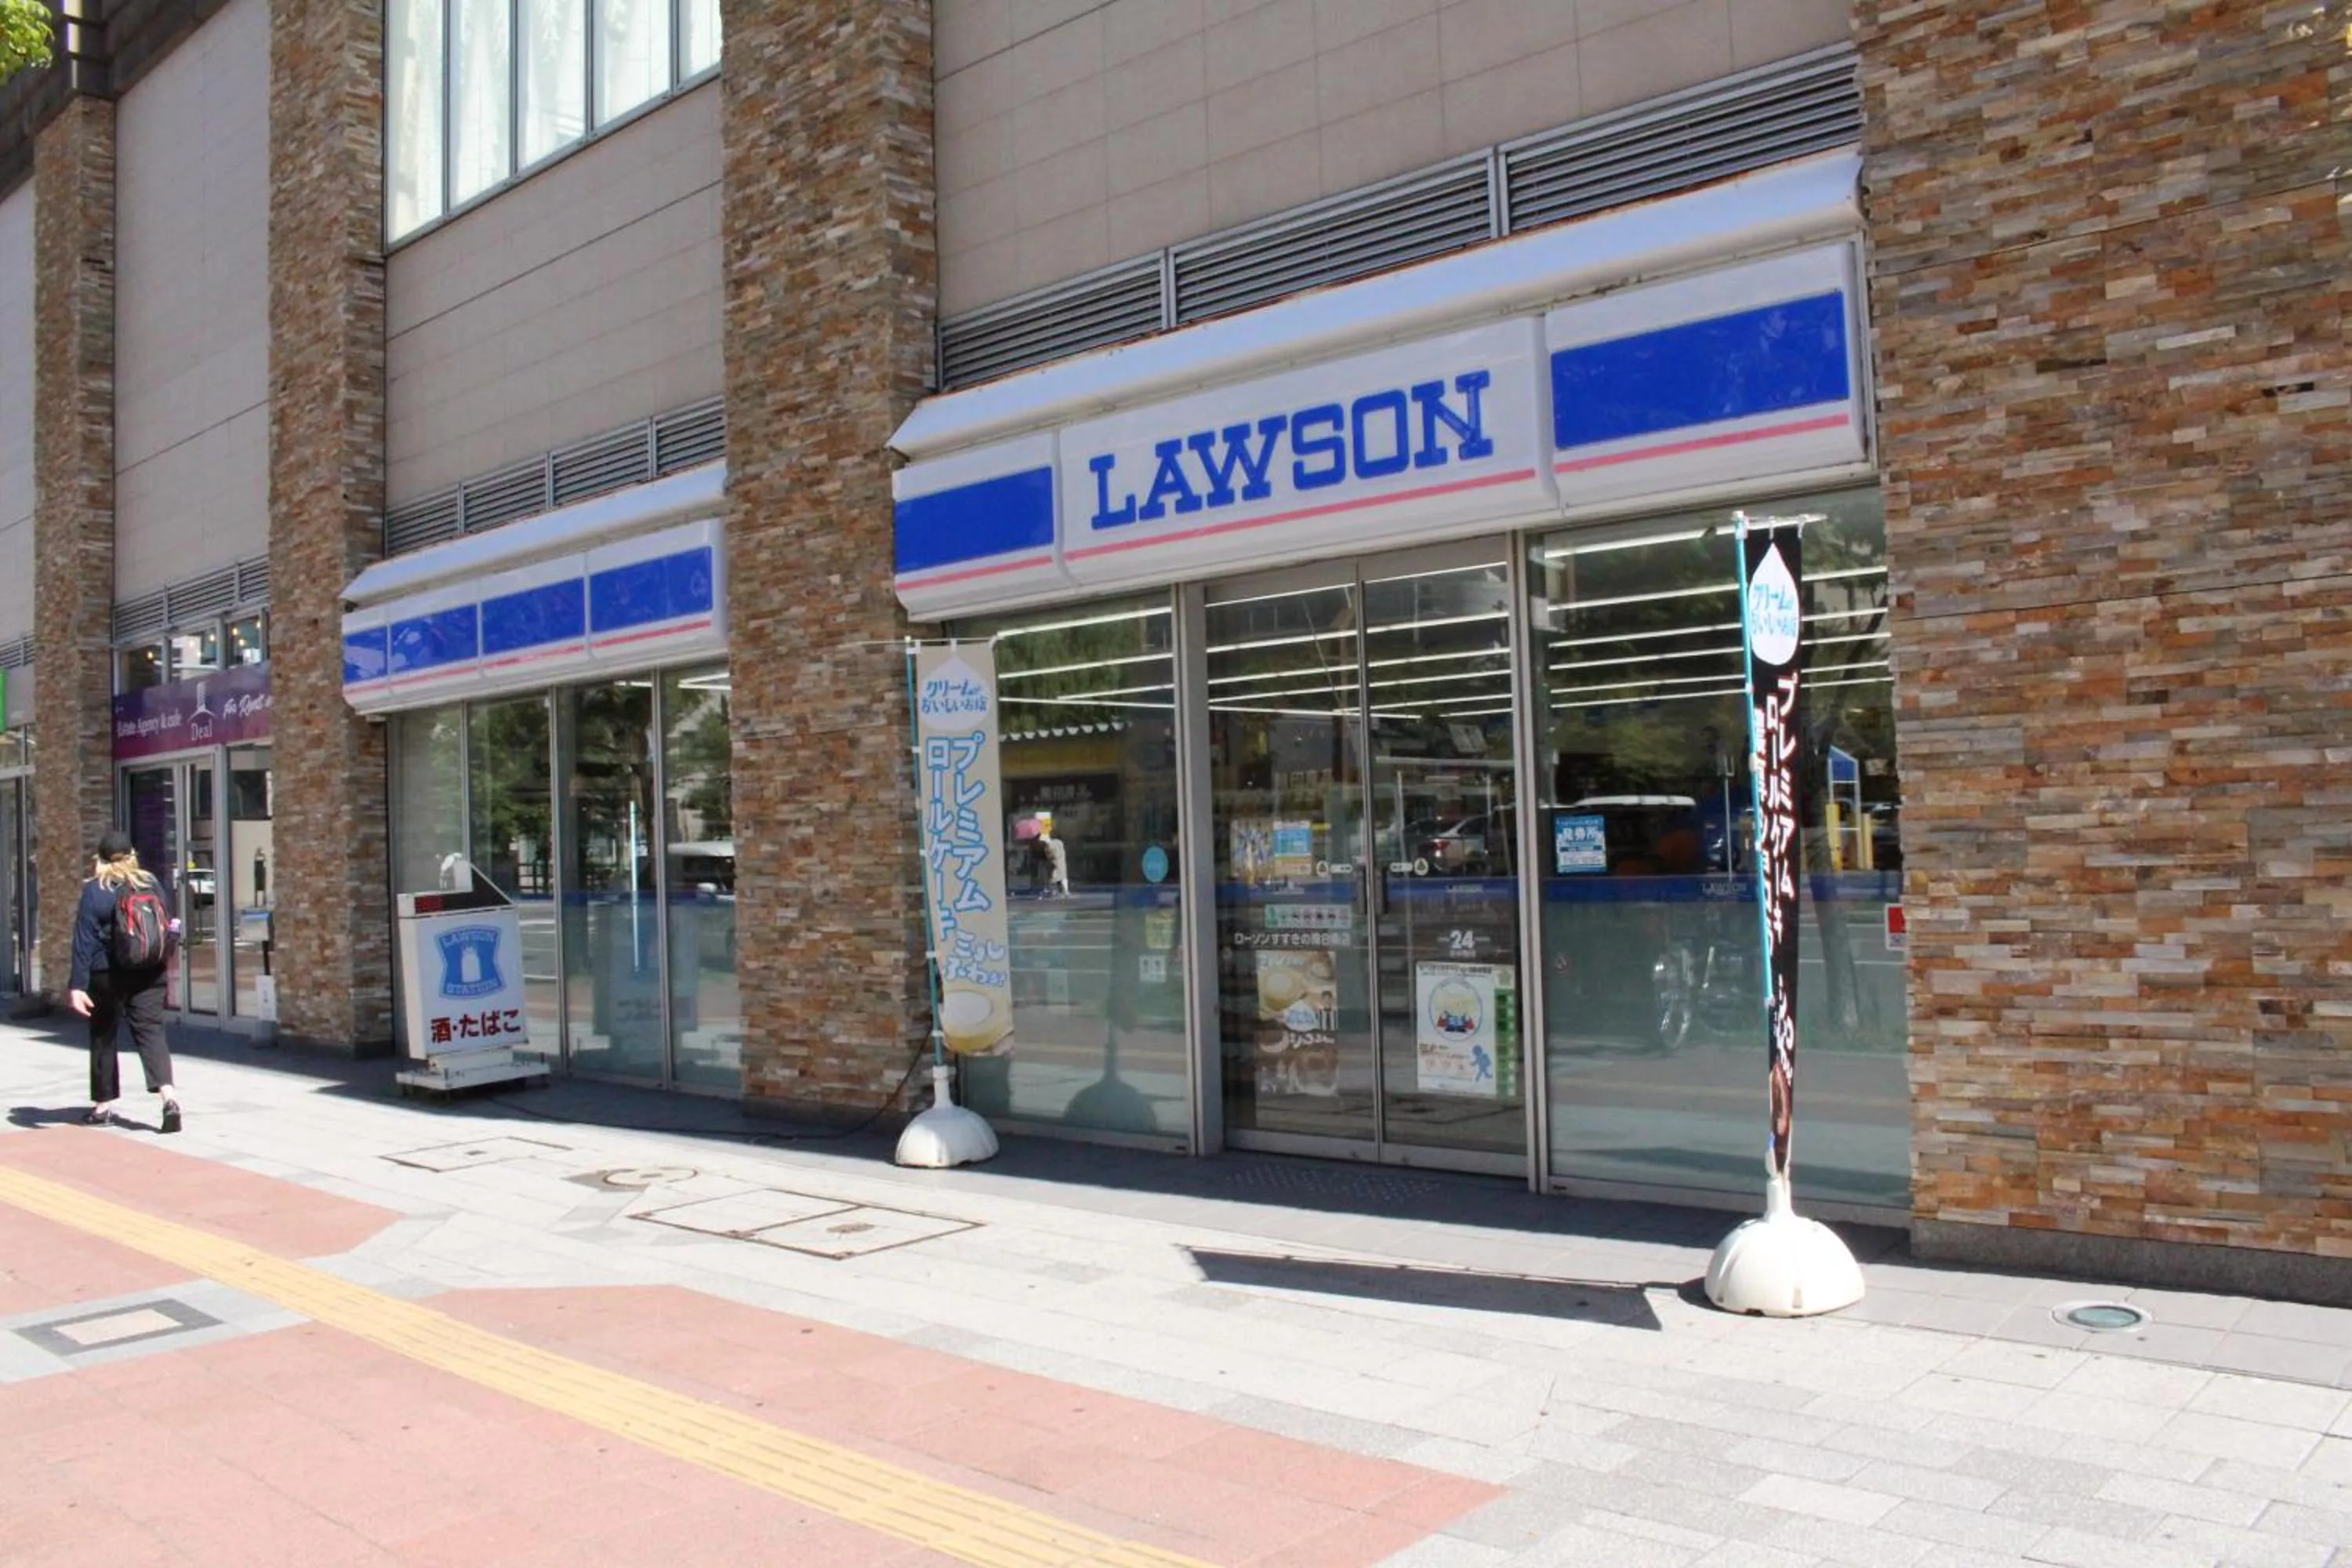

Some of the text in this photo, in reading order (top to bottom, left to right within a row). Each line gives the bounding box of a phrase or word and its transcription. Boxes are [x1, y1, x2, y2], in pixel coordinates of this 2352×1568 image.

[1089, 369, 1494, 530] LAWSON
[191, 718, 213, 742] Deal
[1777, 672, 1798, 899] プレミアム
[926, 736, 958, 942] ロールケーキ
[953, 730, 992, 912] プレミアム
[1766, 695, 1784, 943] ロールケーキ
[1450, 929, 1475, 949] 24
[431, 1009, 521, 1043] 酒・たばこ
